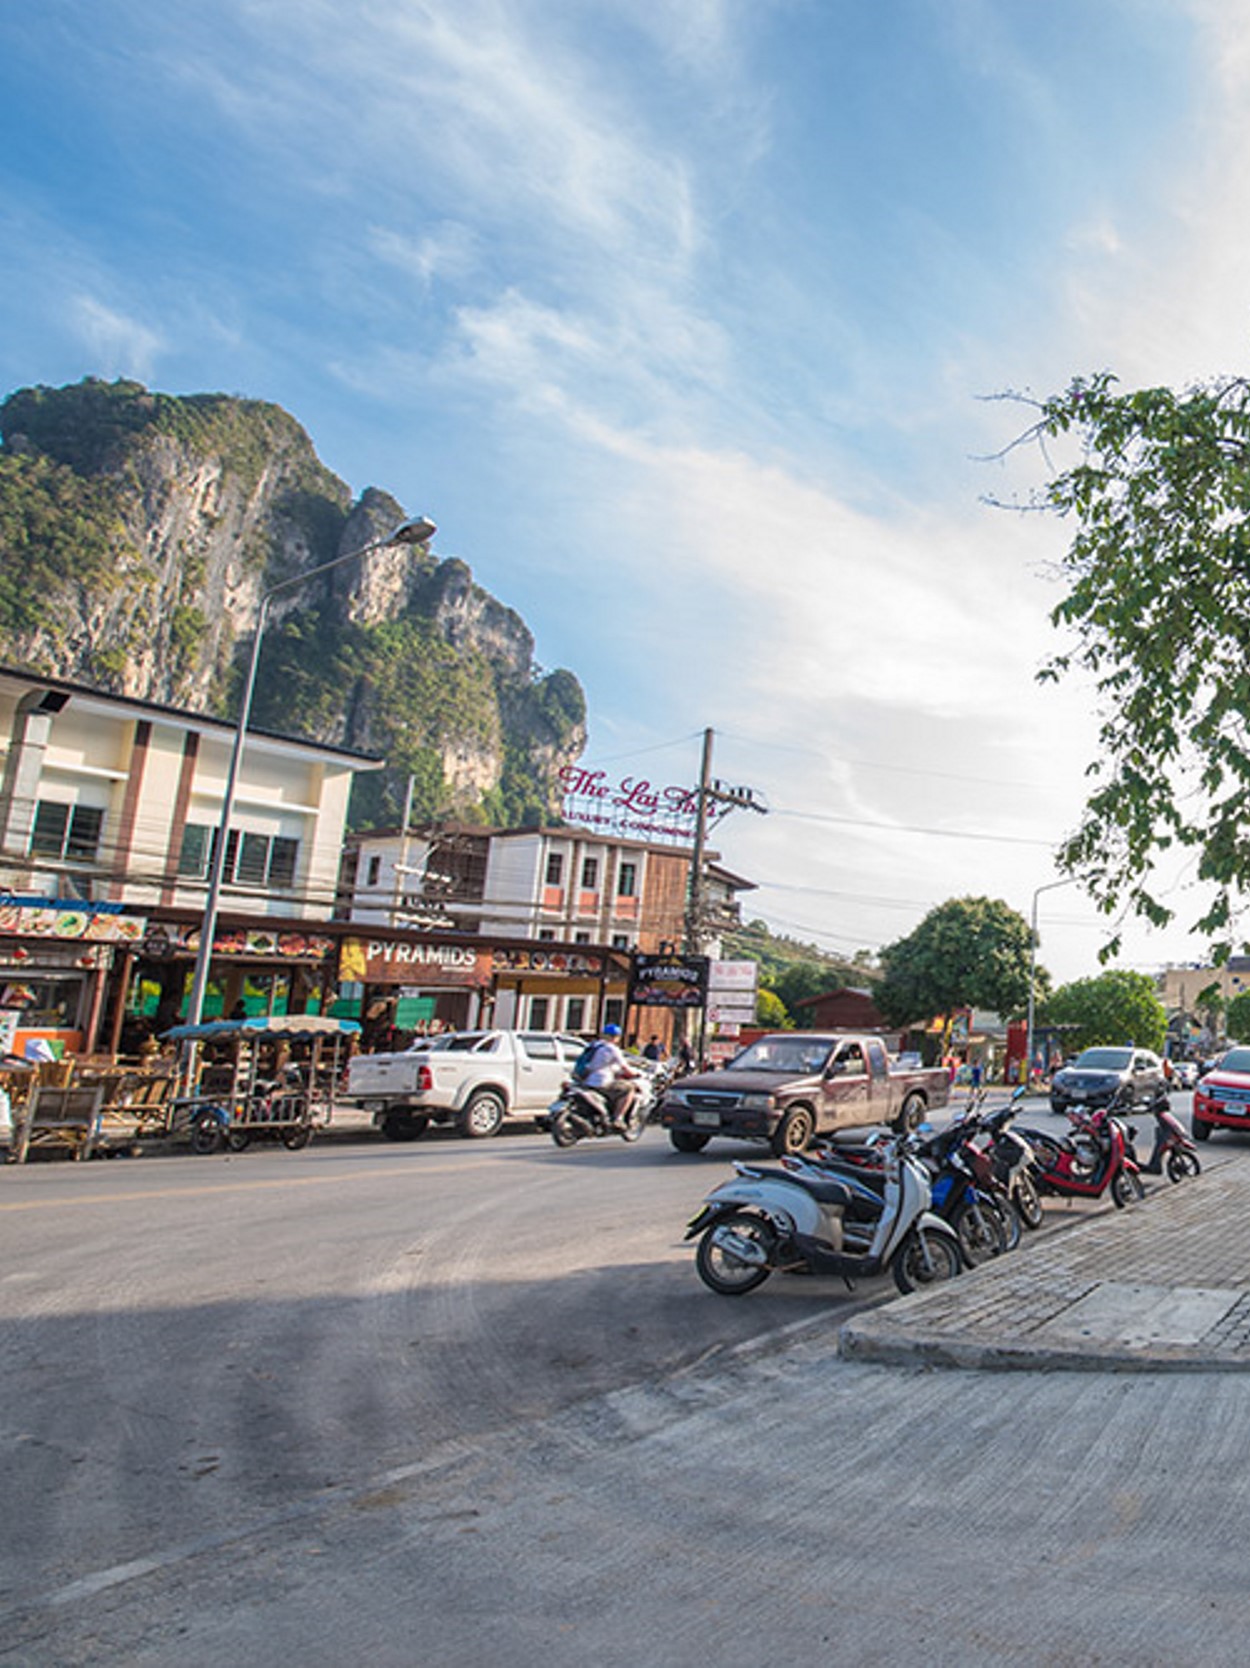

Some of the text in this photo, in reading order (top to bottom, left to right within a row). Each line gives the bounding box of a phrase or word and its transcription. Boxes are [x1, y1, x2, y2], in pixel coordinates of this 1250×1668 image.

[559, 766, 717, 817] The Lai Thi
[366, 941, 476, 966] PYRAMIDS
